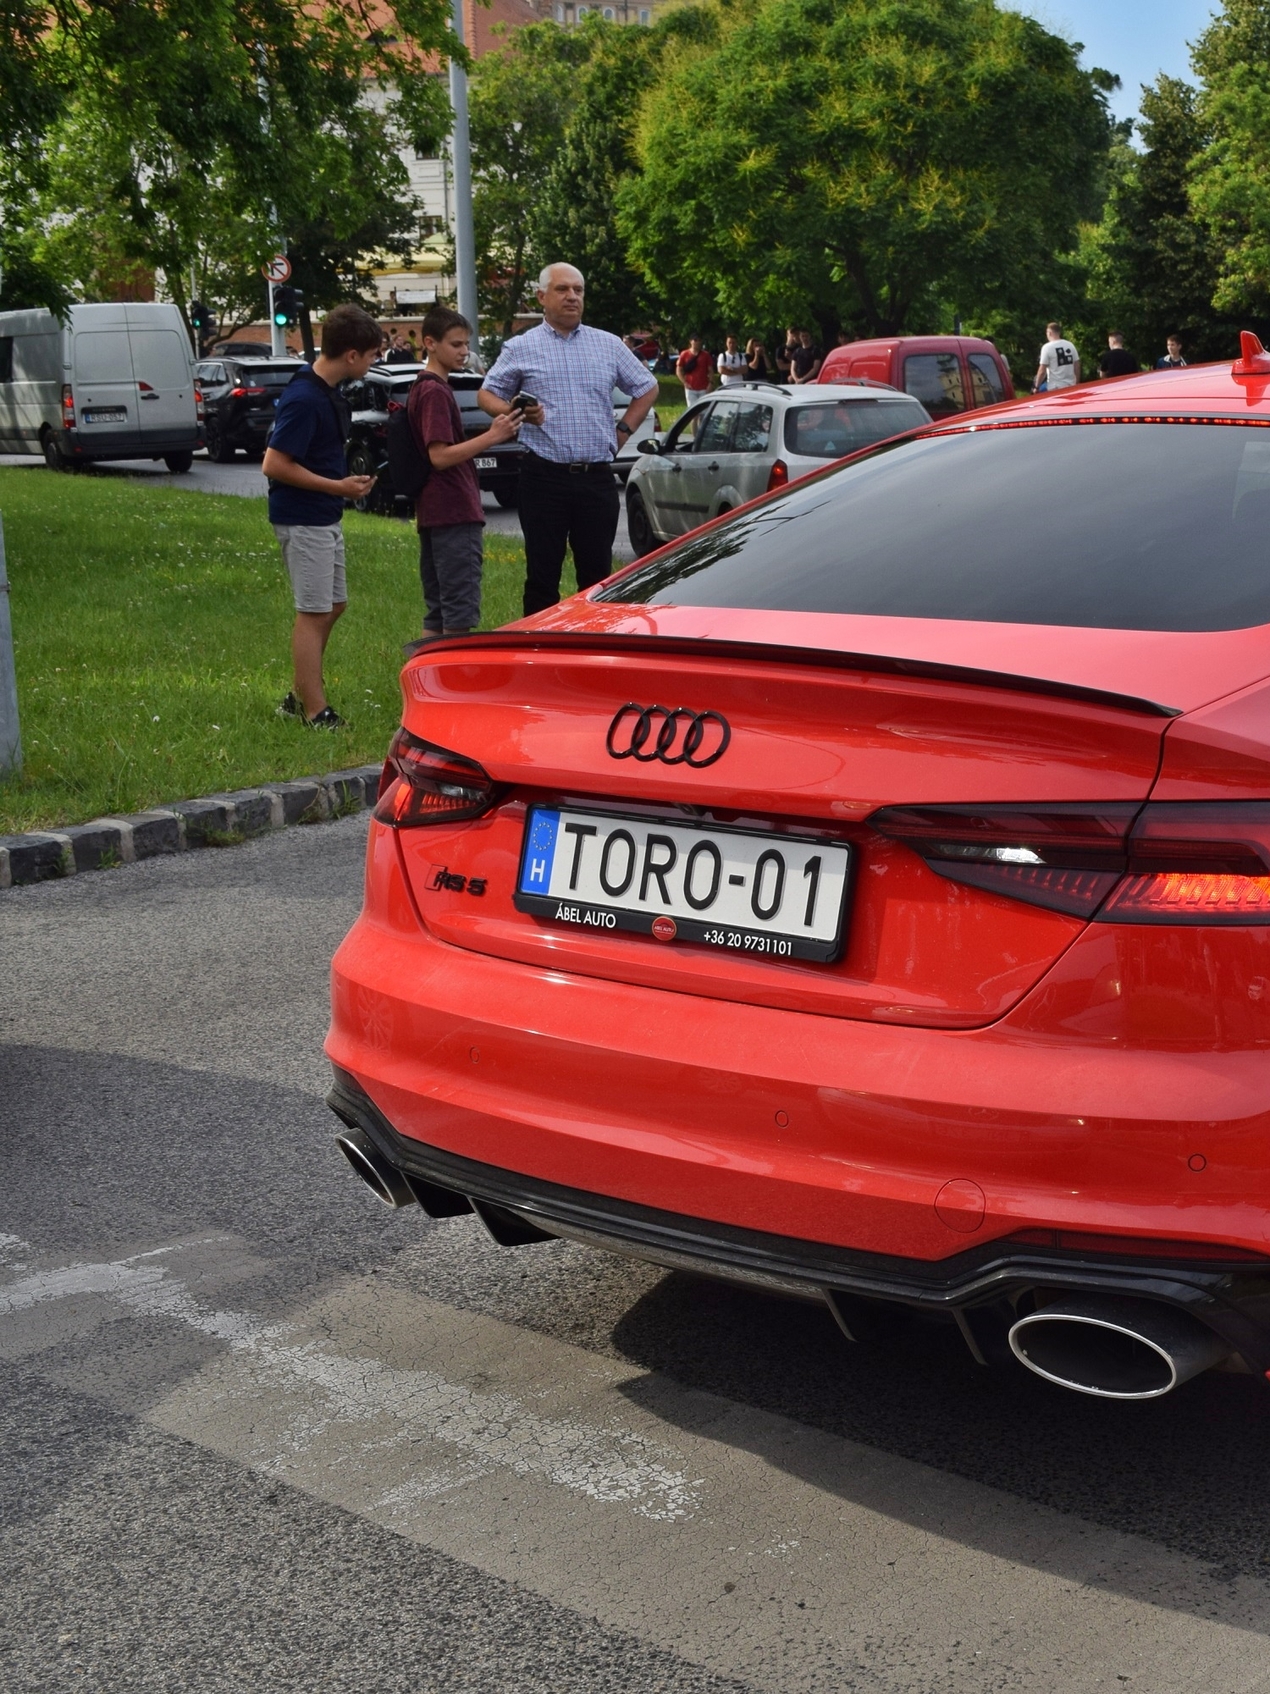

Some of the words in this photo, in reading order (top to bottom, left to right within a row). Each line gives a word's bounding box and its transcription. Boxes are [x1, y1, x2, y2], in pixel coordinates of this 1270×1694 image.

[530, 860, 546, 883] H
[565, 823, 822, 927] TORO-01
[555, 902, 582, 923] ÁBEL
[583, 910, 617, 928] AUTO
[704, 930, 724, 944] +36
[727, 933, 741, 947] 20
[744, 935, 792, 955] 9731101
